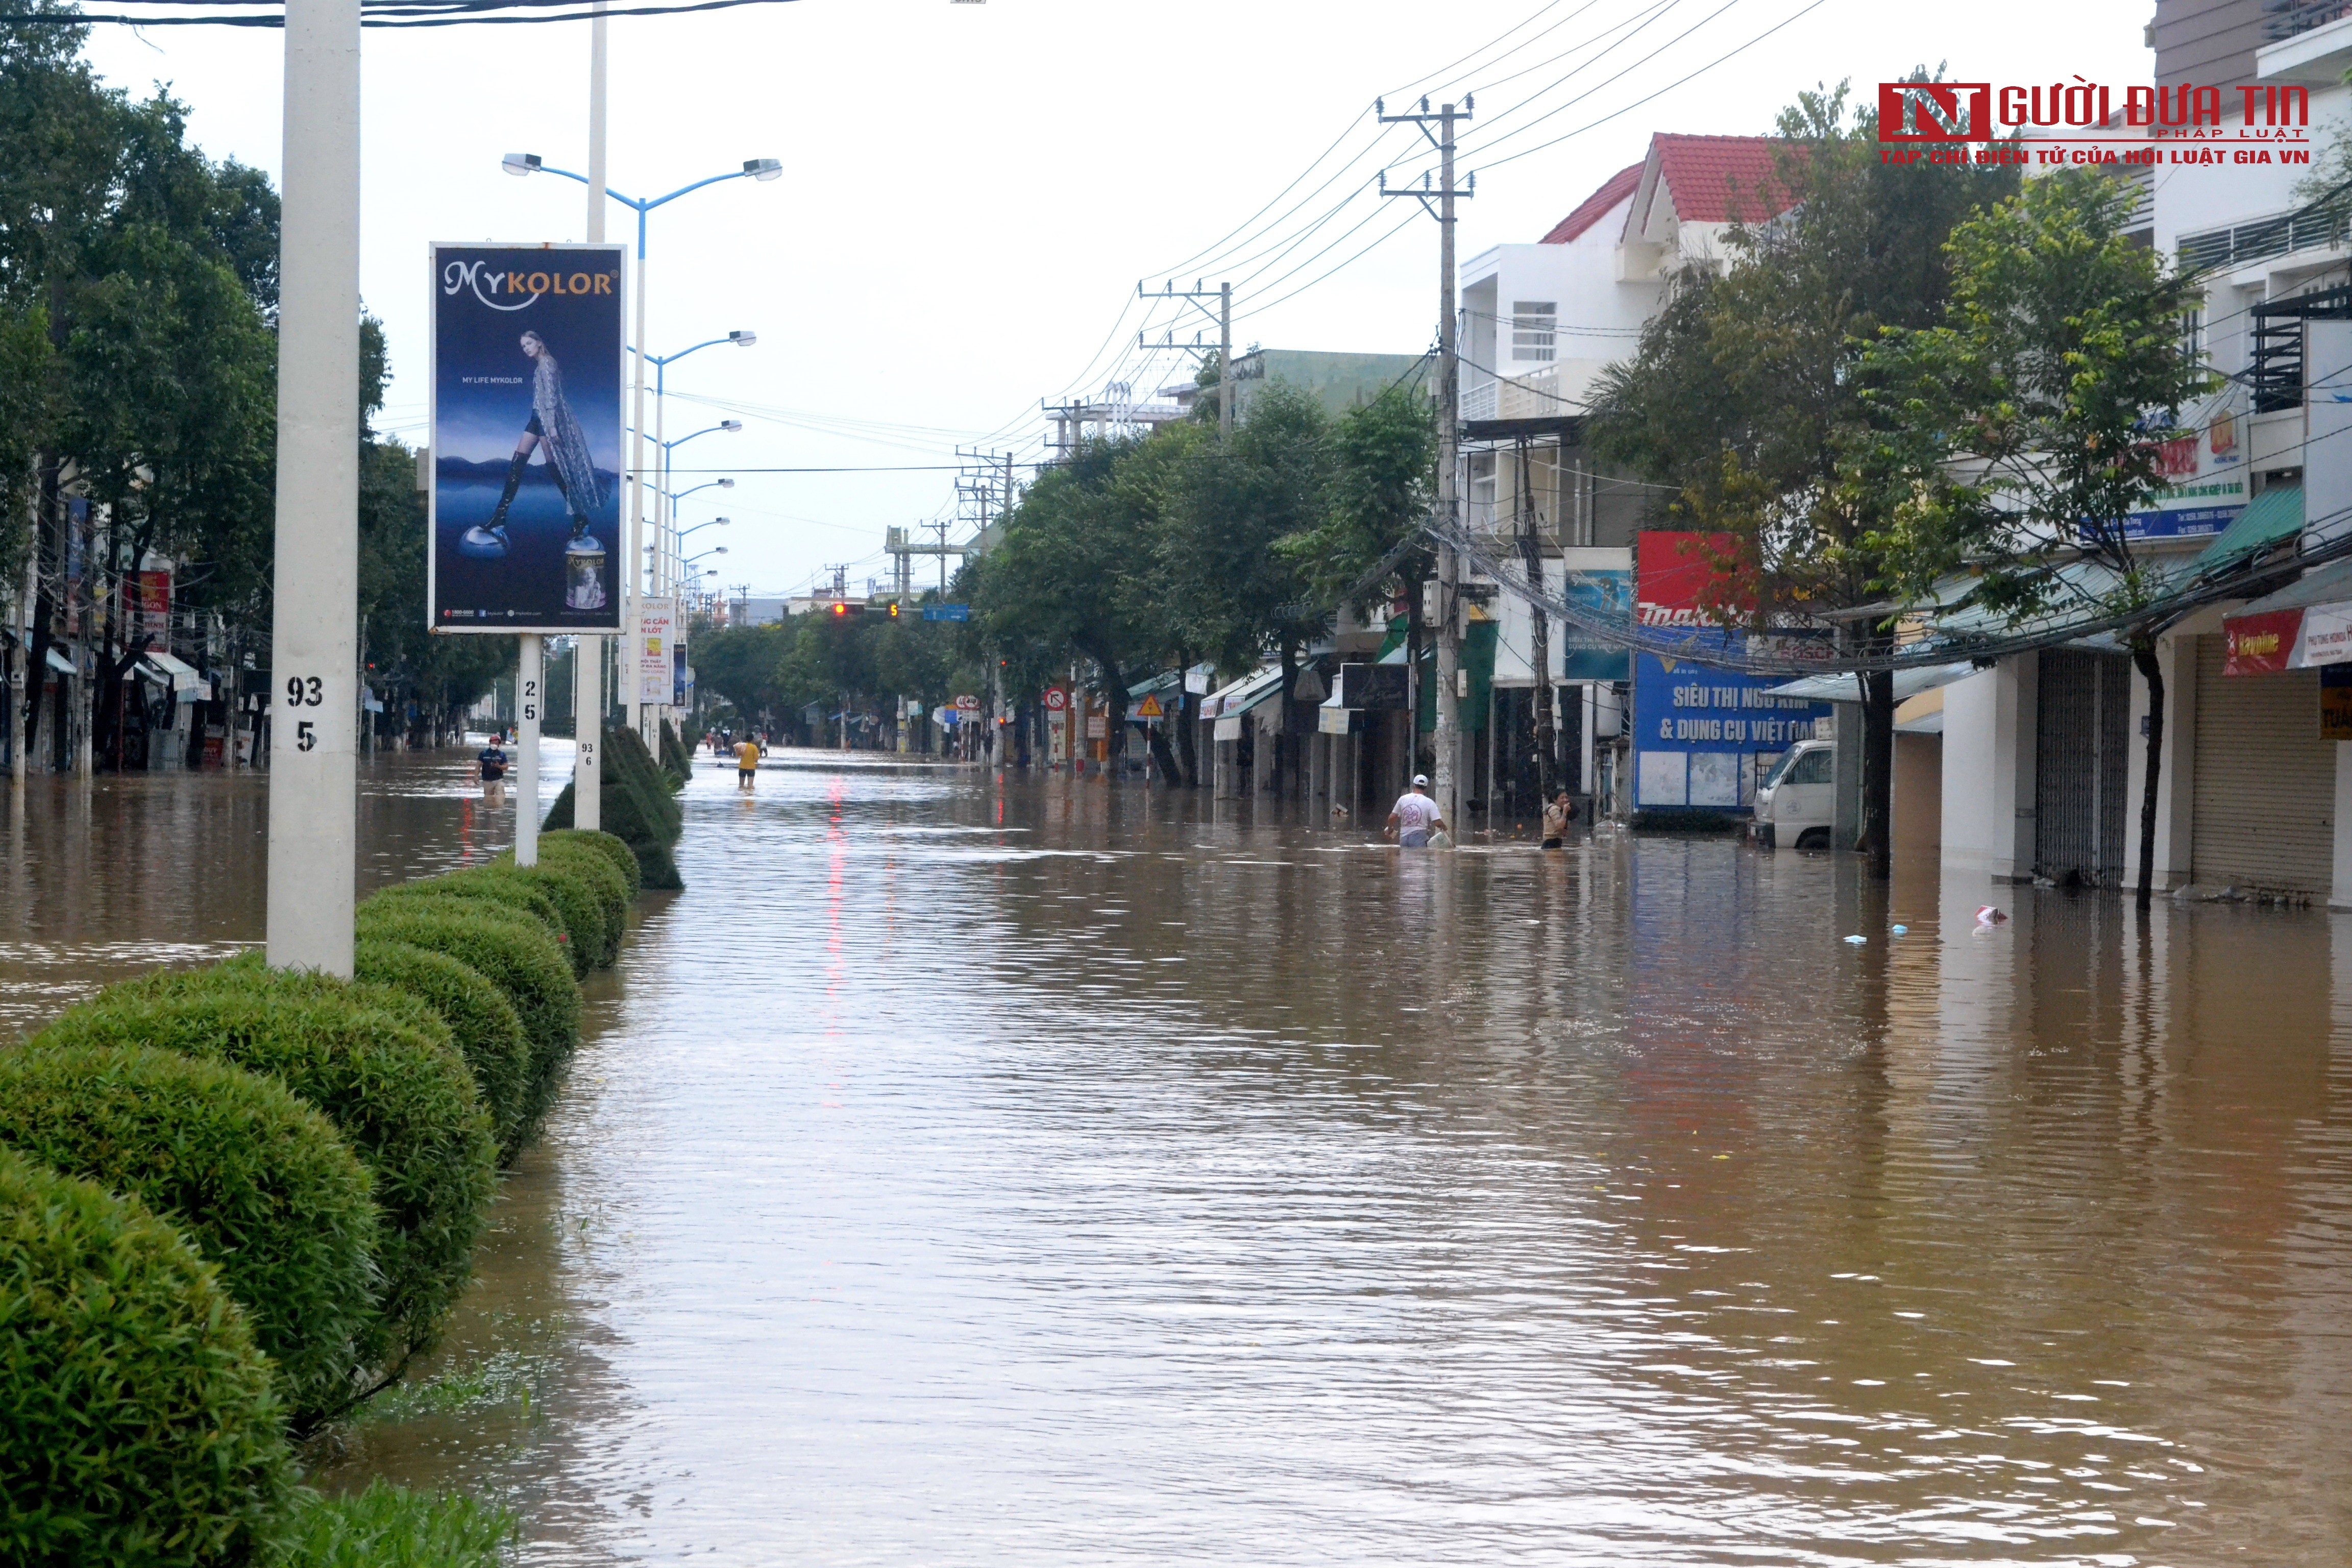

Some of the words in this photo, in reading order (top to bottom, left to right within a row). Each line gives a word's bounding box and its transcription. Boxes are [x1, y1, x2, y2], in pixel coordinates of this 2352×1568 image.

[288, 676, 322, 706] 93
[525, 681, 535, 696] 2
[1673, 682, 1709, 707] SIÊU
[1712, 687, 1738, 711] THỊ
[525, 704, 535, 720] 5
[298, 722, 317, 751] 5
[1660, 719, 1673, 739] &
[1677, 720, 1721, 744] DỤNG
[1724, 720, 1746, 745] CỤ
[1751, 717, 1785, 744] VIỆT
[582, 744, 593, 752] 93
[585, 757, 591, 766] 6
